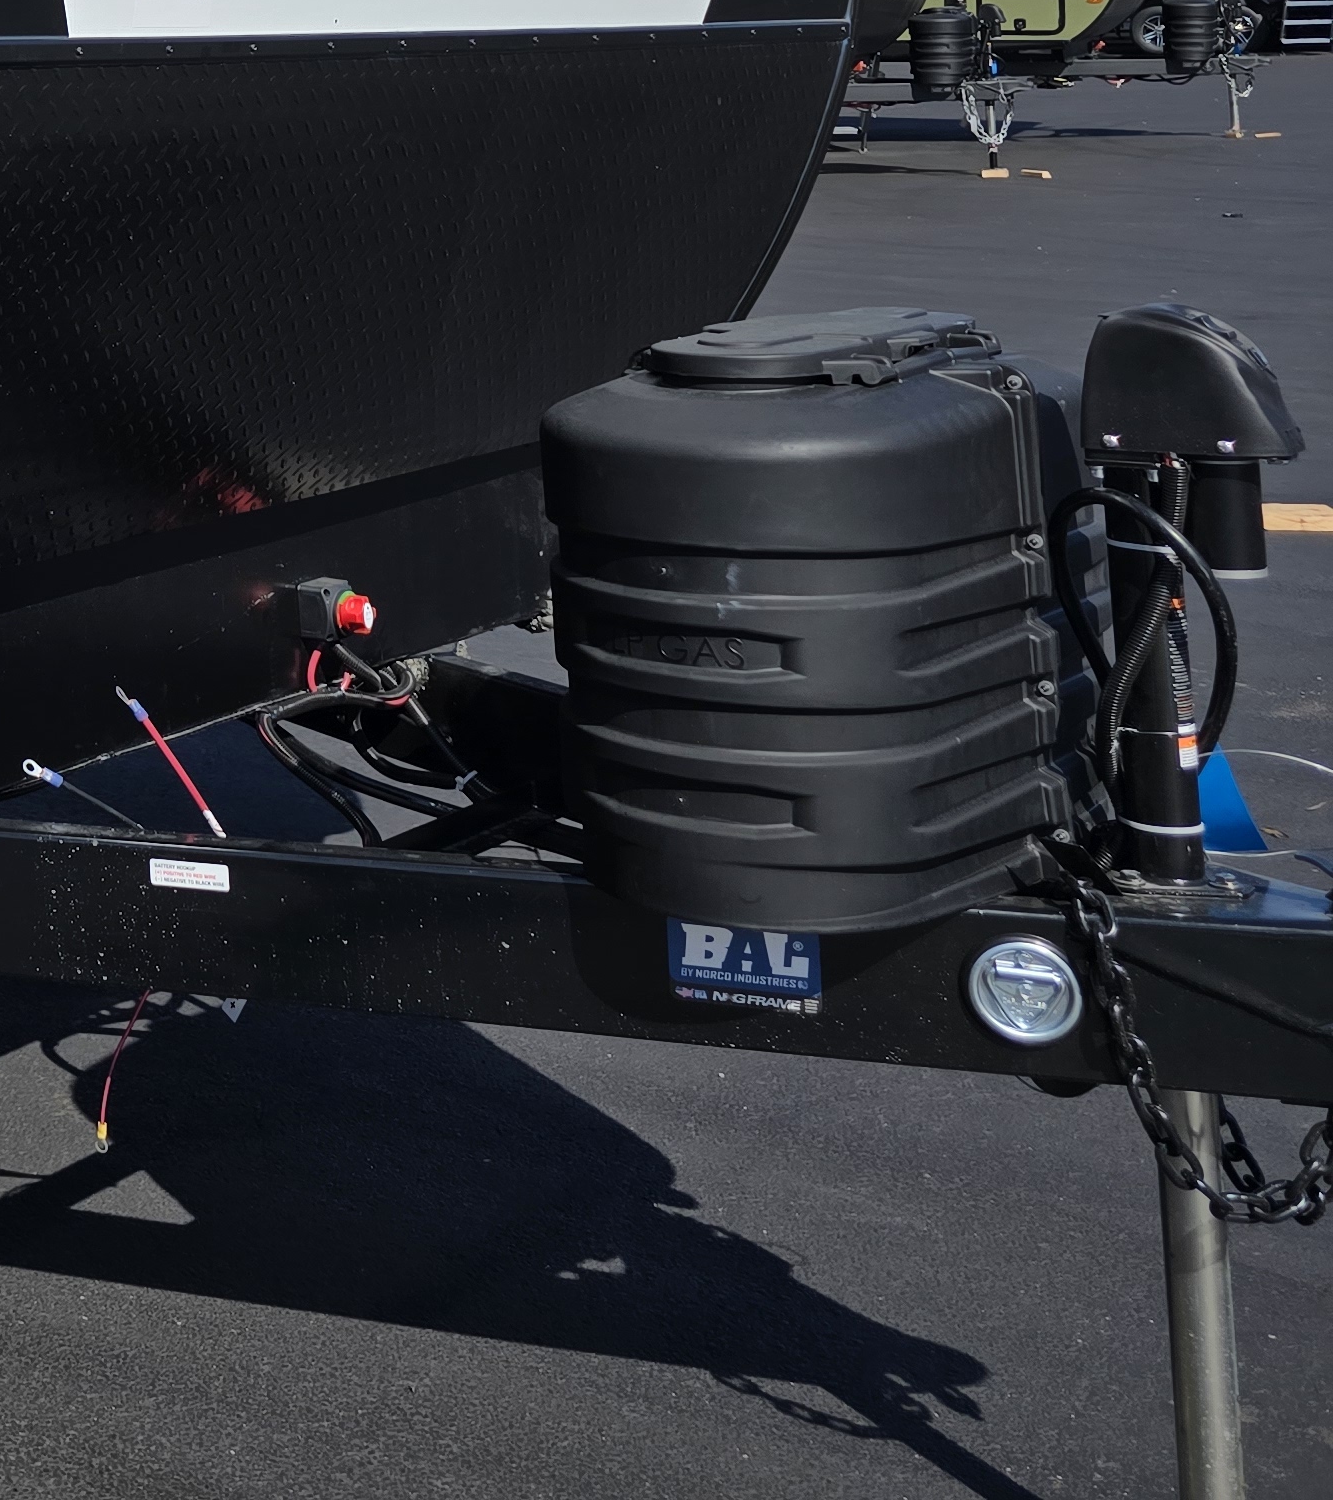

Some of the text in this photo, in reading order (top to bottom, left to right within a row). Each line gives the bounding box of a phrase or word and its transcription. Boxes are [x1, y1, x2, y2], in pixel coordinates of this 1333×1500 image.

[656, 634, 746, 670] GAS
[680, 922, 810, 979] BAL
[680, 967, 797, 989] BY NORCO INDUSTRIES
